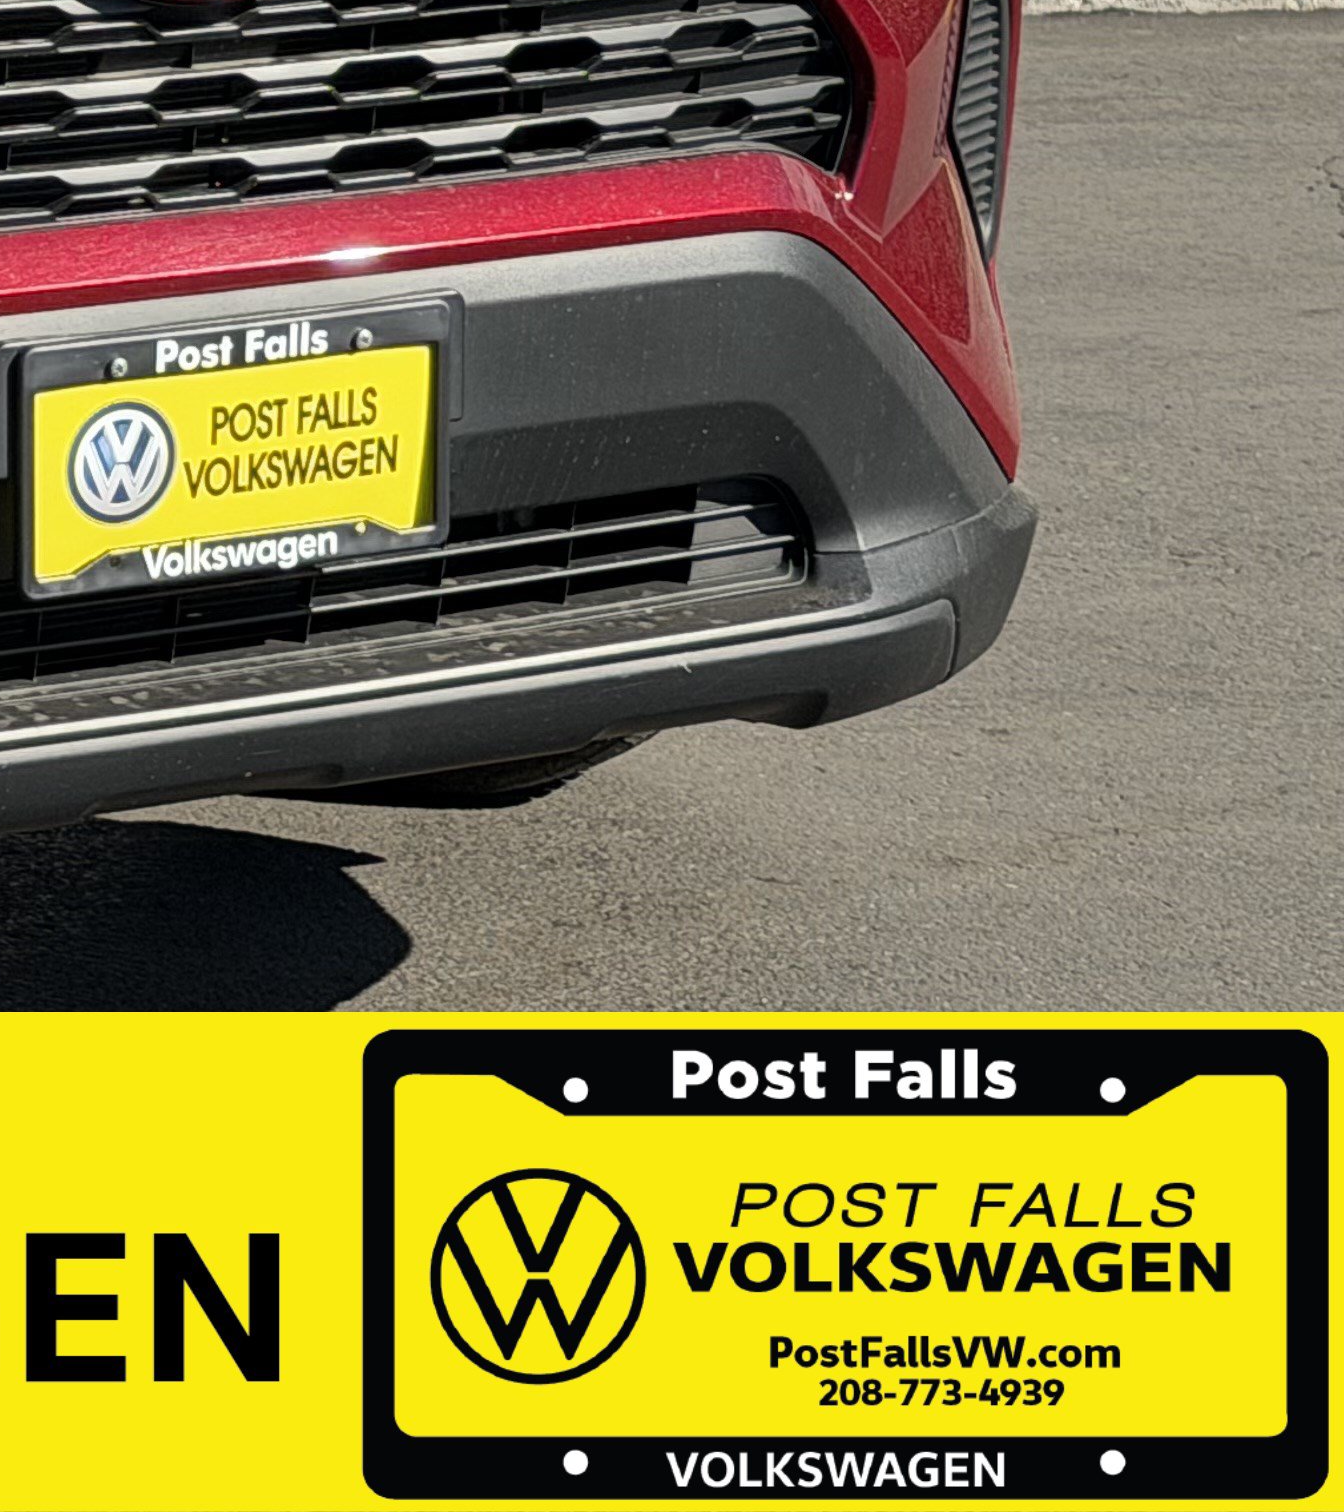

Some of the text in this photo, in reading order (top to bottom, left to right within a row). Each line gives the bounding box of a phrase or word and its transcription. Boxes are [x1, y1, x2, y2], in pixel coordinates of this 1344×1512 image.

[155, 321, 329, 374] Post Falls
[210, 386, 378, 446] POST FALLS
[183, 433, 399, 499] VOLKSWAGEN
[142, 531, 338, 580] Volkswagen
